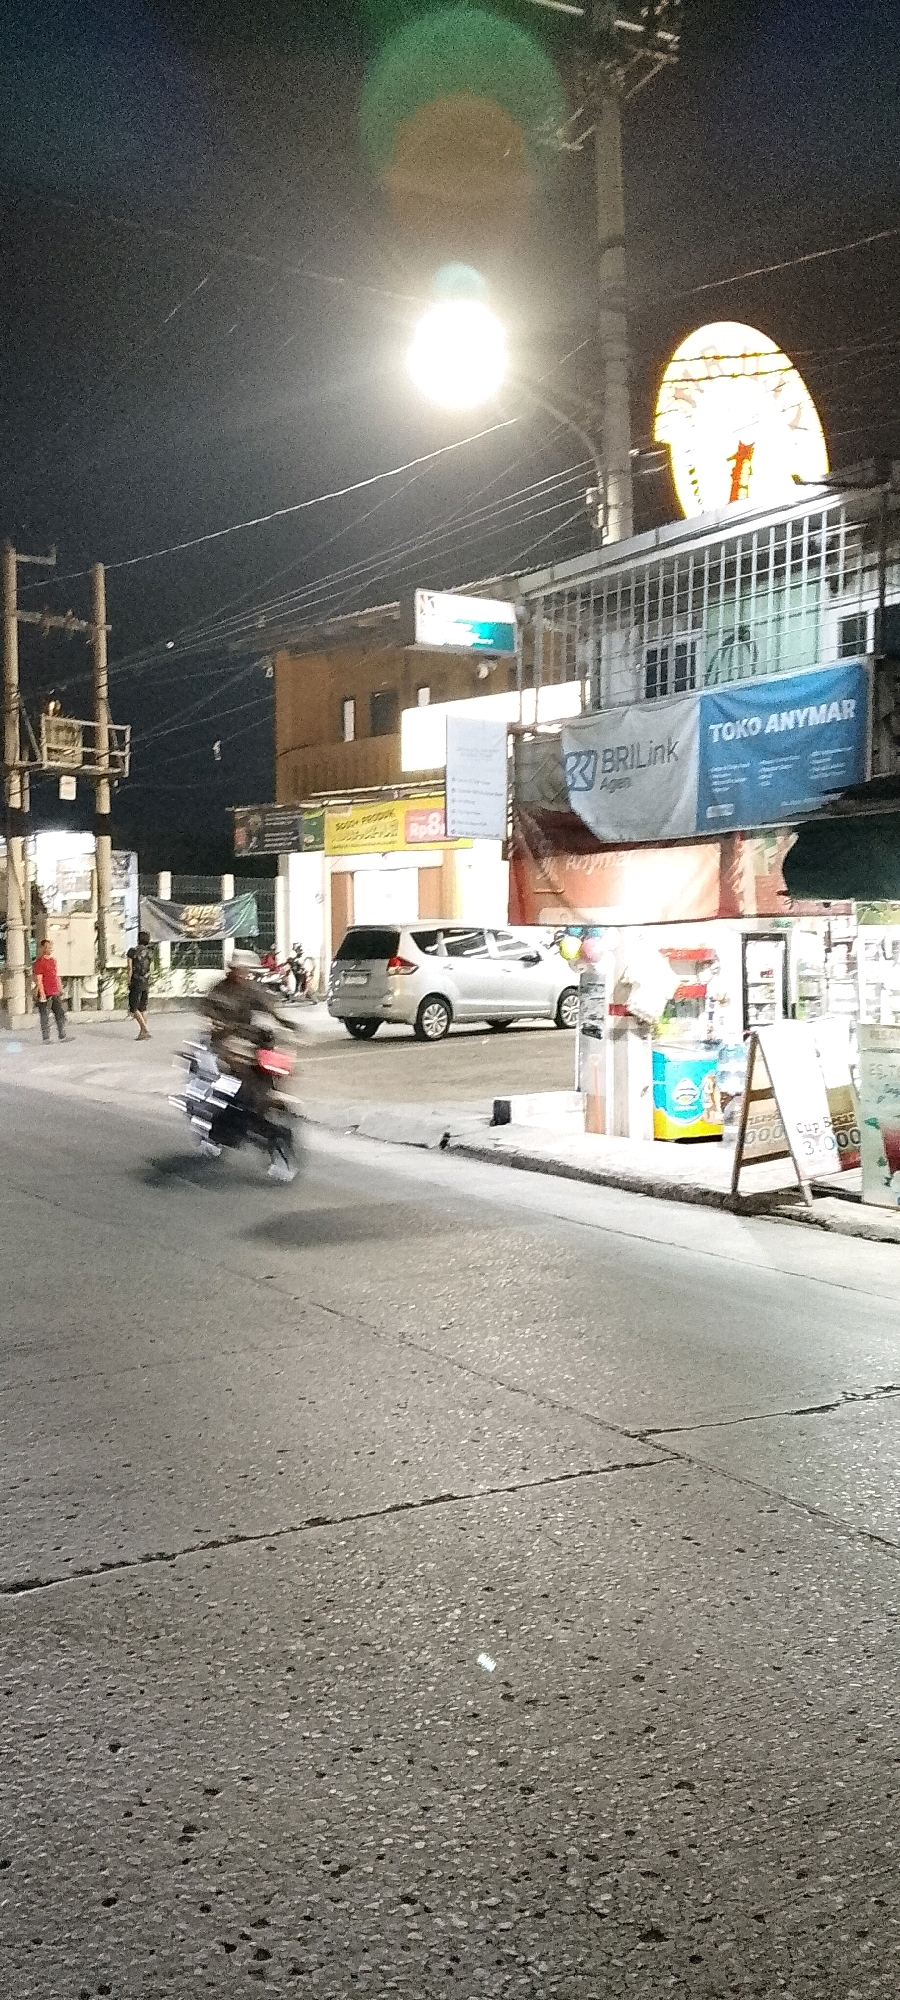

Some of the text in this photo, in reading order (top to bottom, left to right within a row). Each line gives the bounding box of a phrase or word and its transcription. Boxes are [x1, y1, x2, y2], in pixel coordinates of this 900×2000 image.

[709, 699, 856, 743] TOKO ANYMAR
[601, 737, 679, 774] BRILink
[796, 1122, 819, 1133] Cup
[802, 1129, 861, 1156] 3.000
